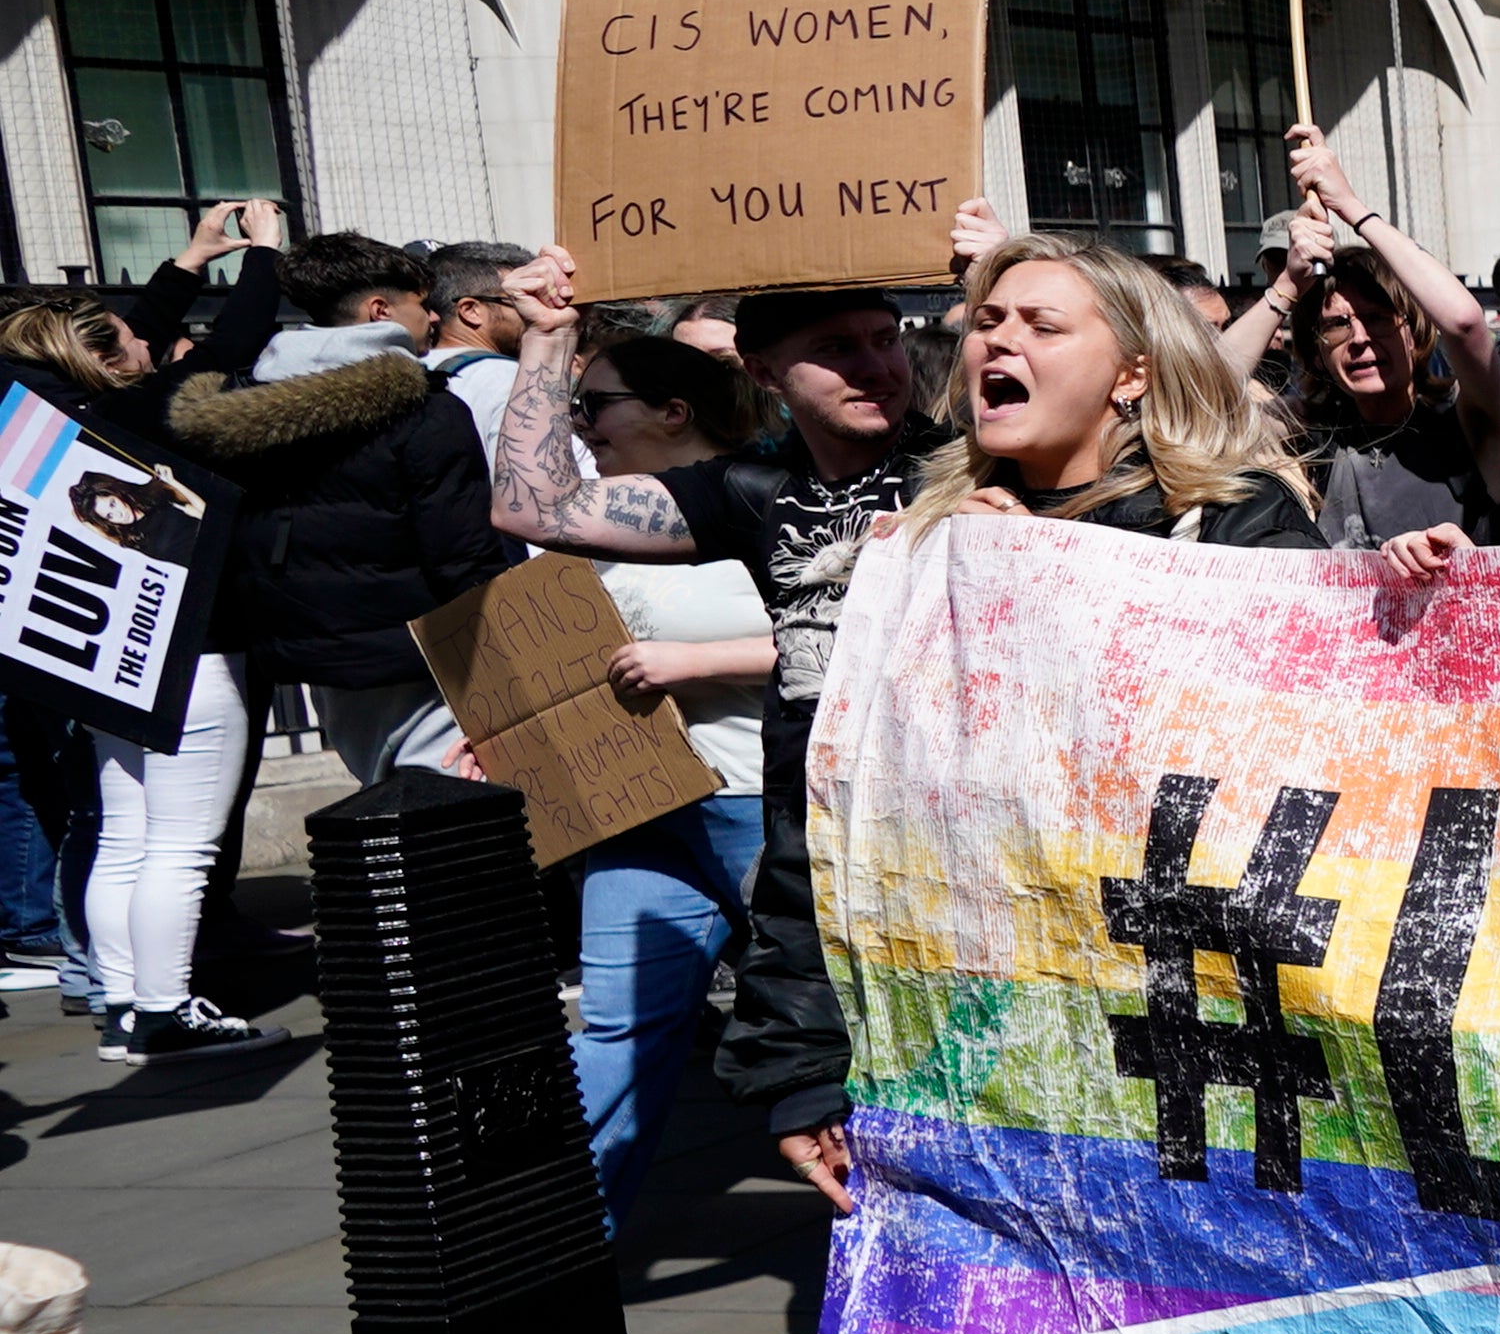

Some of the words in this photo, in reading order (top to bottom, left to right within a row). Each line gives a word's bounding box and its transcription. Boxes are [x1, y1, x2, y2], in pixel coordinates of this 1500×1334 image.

[601, 10, 701, 55] CIS
[748, 2, 948, 47] WOMEN,
[618, 90, 770, 135] THEY'RE
[804, 77, 955, 118] COMING
[591, 193, 677, 242] FOR
[710, 181, 804, 225] YOU
[838, 177, 948, 217] NEXT
[18, 524, 124, 673] LUV
[431, 565, 599, 683] TRANS
[114, 643, 148, 689] THE
[503, 766, 560, 815] RE
[557, 718, 664, 787] HUMAN
[552, 765, 675, 844] RIGHTS
